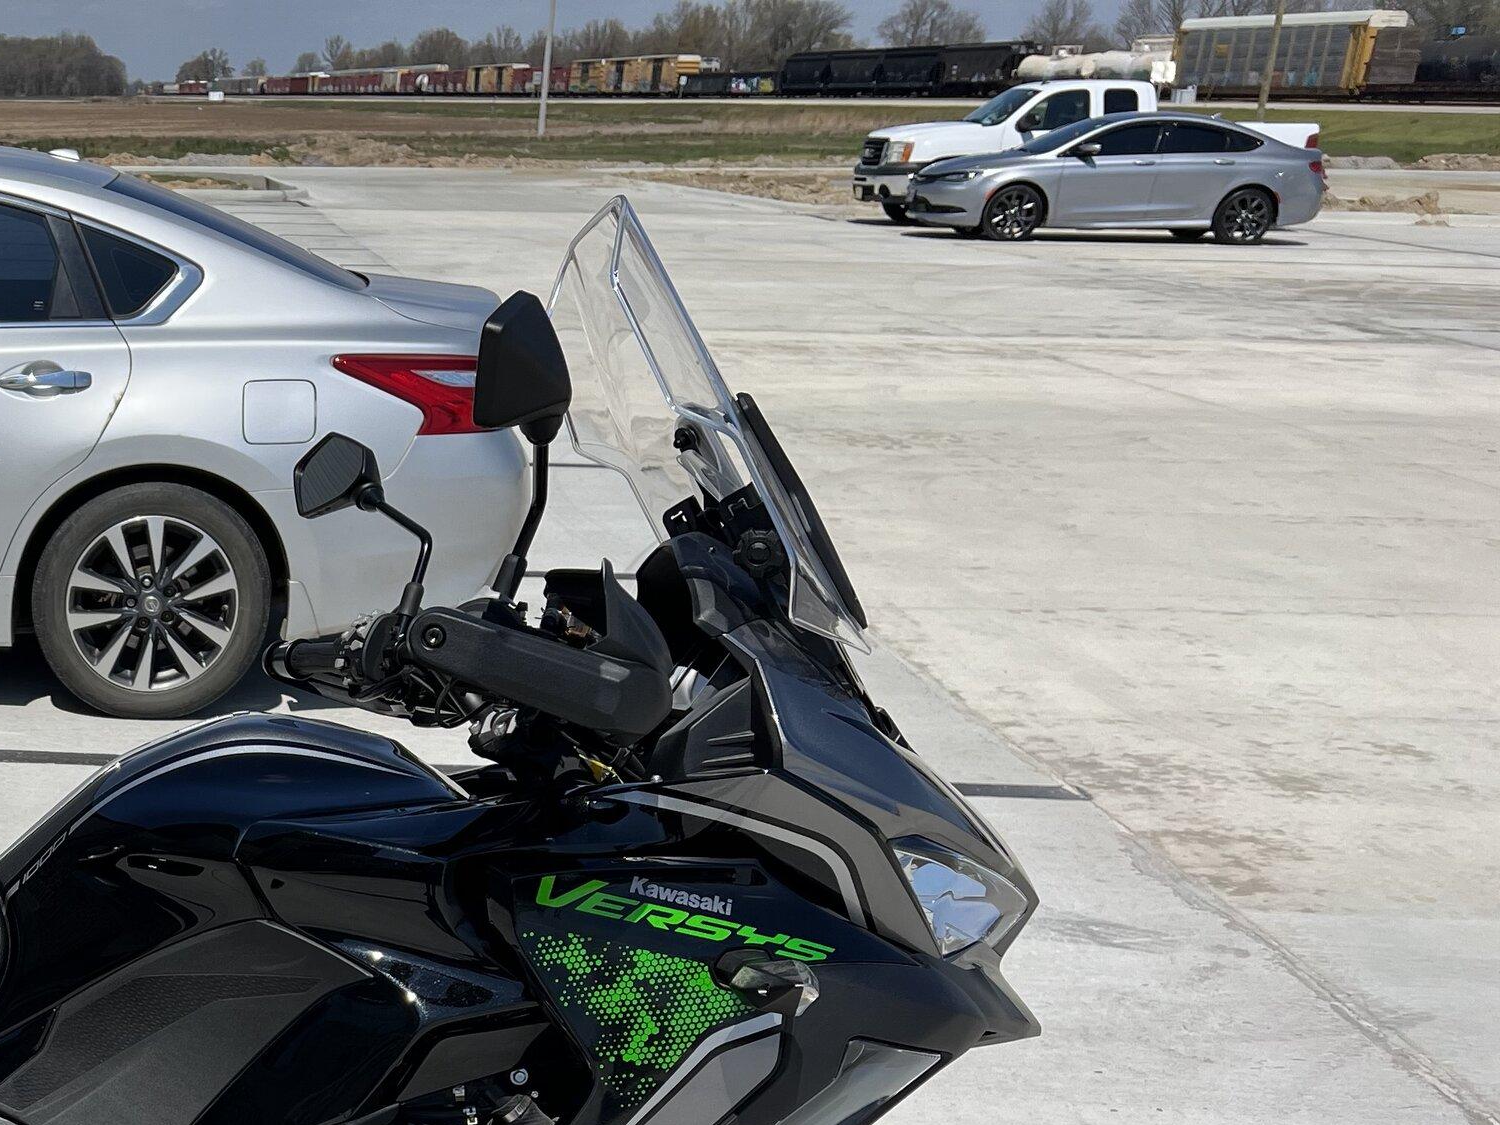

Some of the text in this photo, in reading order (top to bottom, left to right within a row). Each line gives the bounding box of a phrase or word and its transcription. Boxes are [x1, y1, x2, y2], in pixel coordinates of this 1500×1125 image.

[22, 831, 68, 885] 1000
[535, 875, 836, 962] VERSYS
[629, 876, 733, 916] Kawasaki
